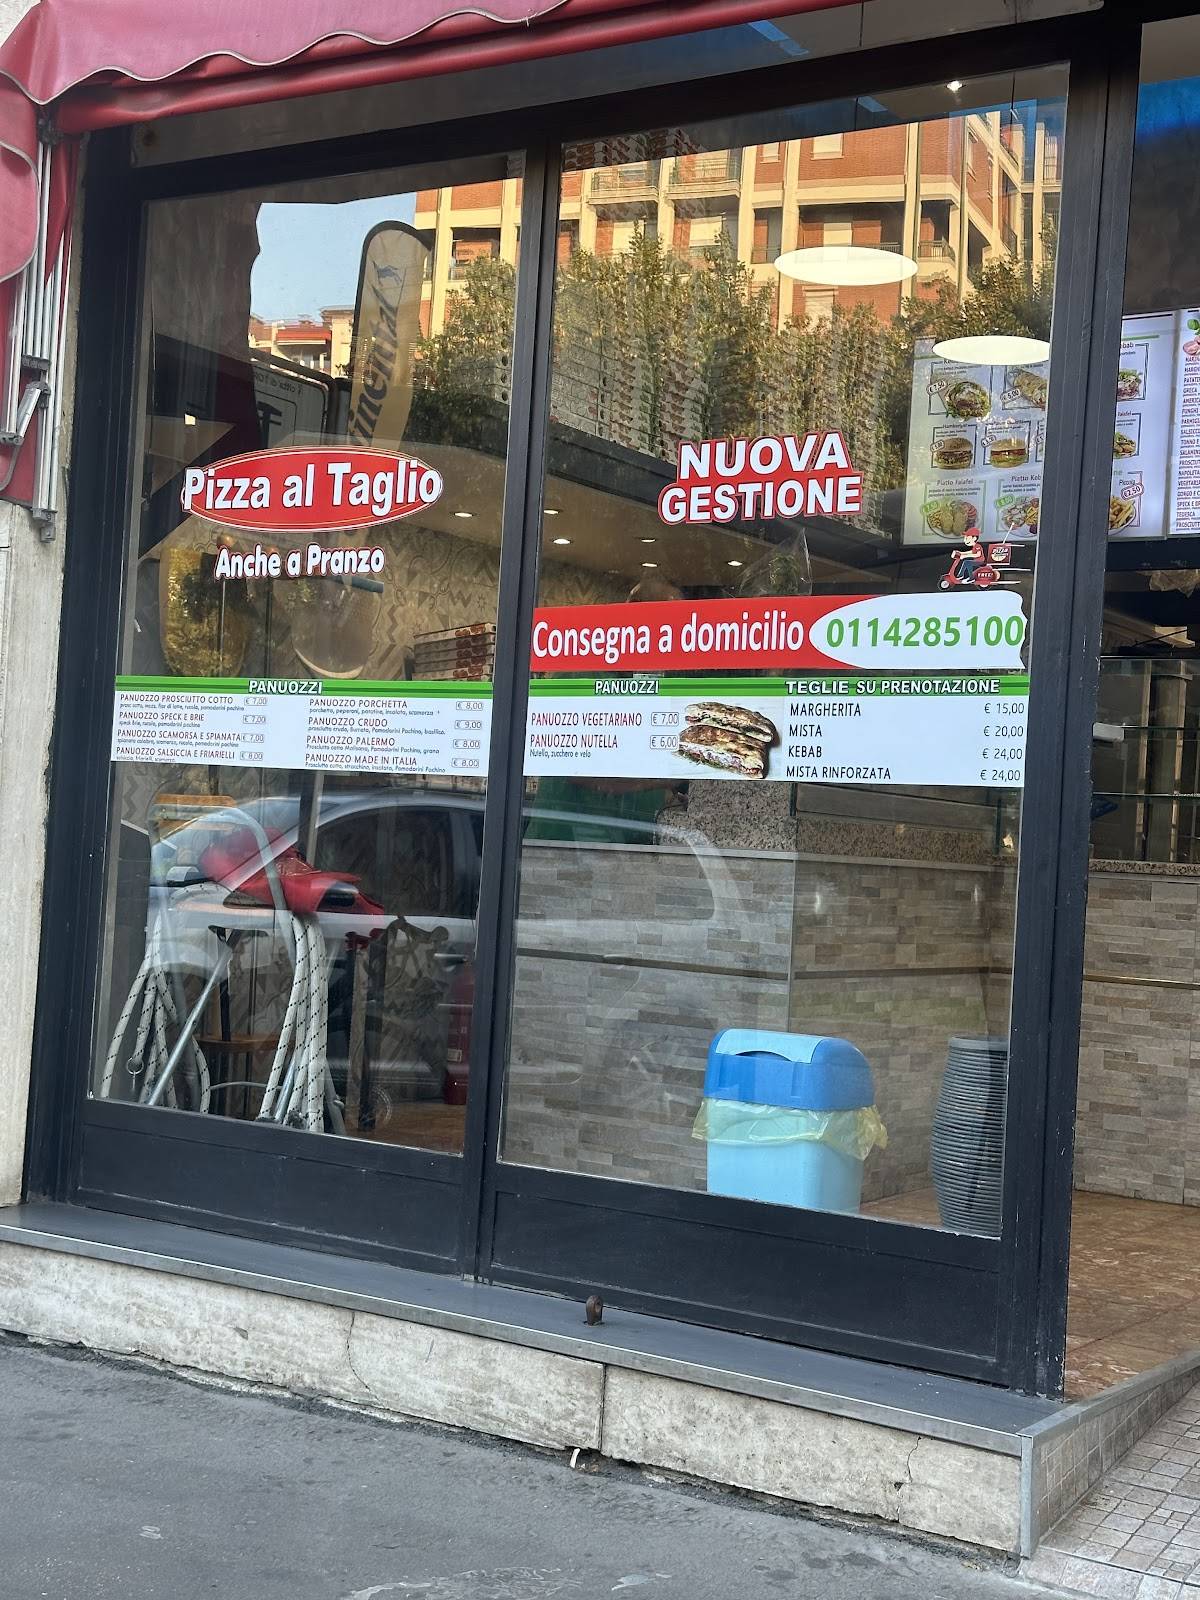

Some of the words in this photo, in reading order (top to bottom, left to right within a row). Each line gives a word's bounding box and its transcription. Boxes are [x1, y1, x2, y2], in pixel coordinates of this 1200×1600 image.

[678, 432, 849, 480] NUOVA
[183, 466, 270, 511] Pizza
[282, 464, 315, 508] al
[326, 459, 441, 517] Taglio
[661, 475, 862, 524] GESTIONE
[214, 543, 281, 580] Anche
[286, 552, 301, 577] a
[306, 542, 385, 577] Pranzo
[532, 620, 651, 664] Consegna
[658, 627, 673, 653] a
[680, 608, 804, 653] domicilio
[826, 615, 1025, 648] 0114285100
[248, 679, 322, 694] PANUOZZI
[594, 680, 659, 694] PANUOZZI
[785, 680, 849, 694] TEGLIE
[856, 680, 876, 694] SU
[880, 679, 1000, 694] PRENOTAZIONE
[120, 693, 160, 702] PANUOZZO
[161, 694, 206, 704] PROSCIUTTO
[208, 696, 234, 704] COTTO
[309, 698, 356, 707] PANUOZZO
[358, 700, 408, 708] PORCHETTA
[790, 702, 862, 717] MARGHERITA
[984, 703, 990, 714] €
[996, 702, 1024, 715] 15,00
[119, 711, 159, 720] PANUOZZO
[160, 712, 182, 720] SPECK
[308, 716, 355, 726] PANUOZZO
[358, 718, 388, 727] CRUDO
[530, 712, 579, 726] PANUOZZO
[582, 712, 642, 726] VEGETARIANO
[653, 715, 658, 724] €
[660, 714, 678, 726] 7,00
[117, 729, 156, 738] PANUOZZO
[206, 732, 241, 741] SPIANATA
[789, 724, 822, 737] MISTA
[983, 726, 990, 736] €
[995, 726, 1024, 738] 20,00
[306, 735, 353, 745] PANUOZZO
[356, 737, 395, 746] PALERMO
[530, 734, 578, 748] PANUOZZO
[580, 734, 618, 748] NUTELLA
[652, 738, 657, 747] €
[660, 737, 677, 748] 6,00
[116, 746, 155, 756] PANUOZZO
[157, 748, 192, 758] SALSICCIA
[788, 745, 822, 758] KEBAB
[982, 748, 989, 759] €
[994, 748, 1023, 761] 24,00
[305, 753, 351, 763] PANUOZZO
[354, 755, 378, 764] MADE
[381, 756, 390, 764] IN
[392, 757, 417, 765] ITALIA
[786, 766, 818, 778] MISTA
[822, 766, 891, 780] RINFORZATA
[980, 770, 987, 780] €
[991, 769, 1020, 782] 24,00
